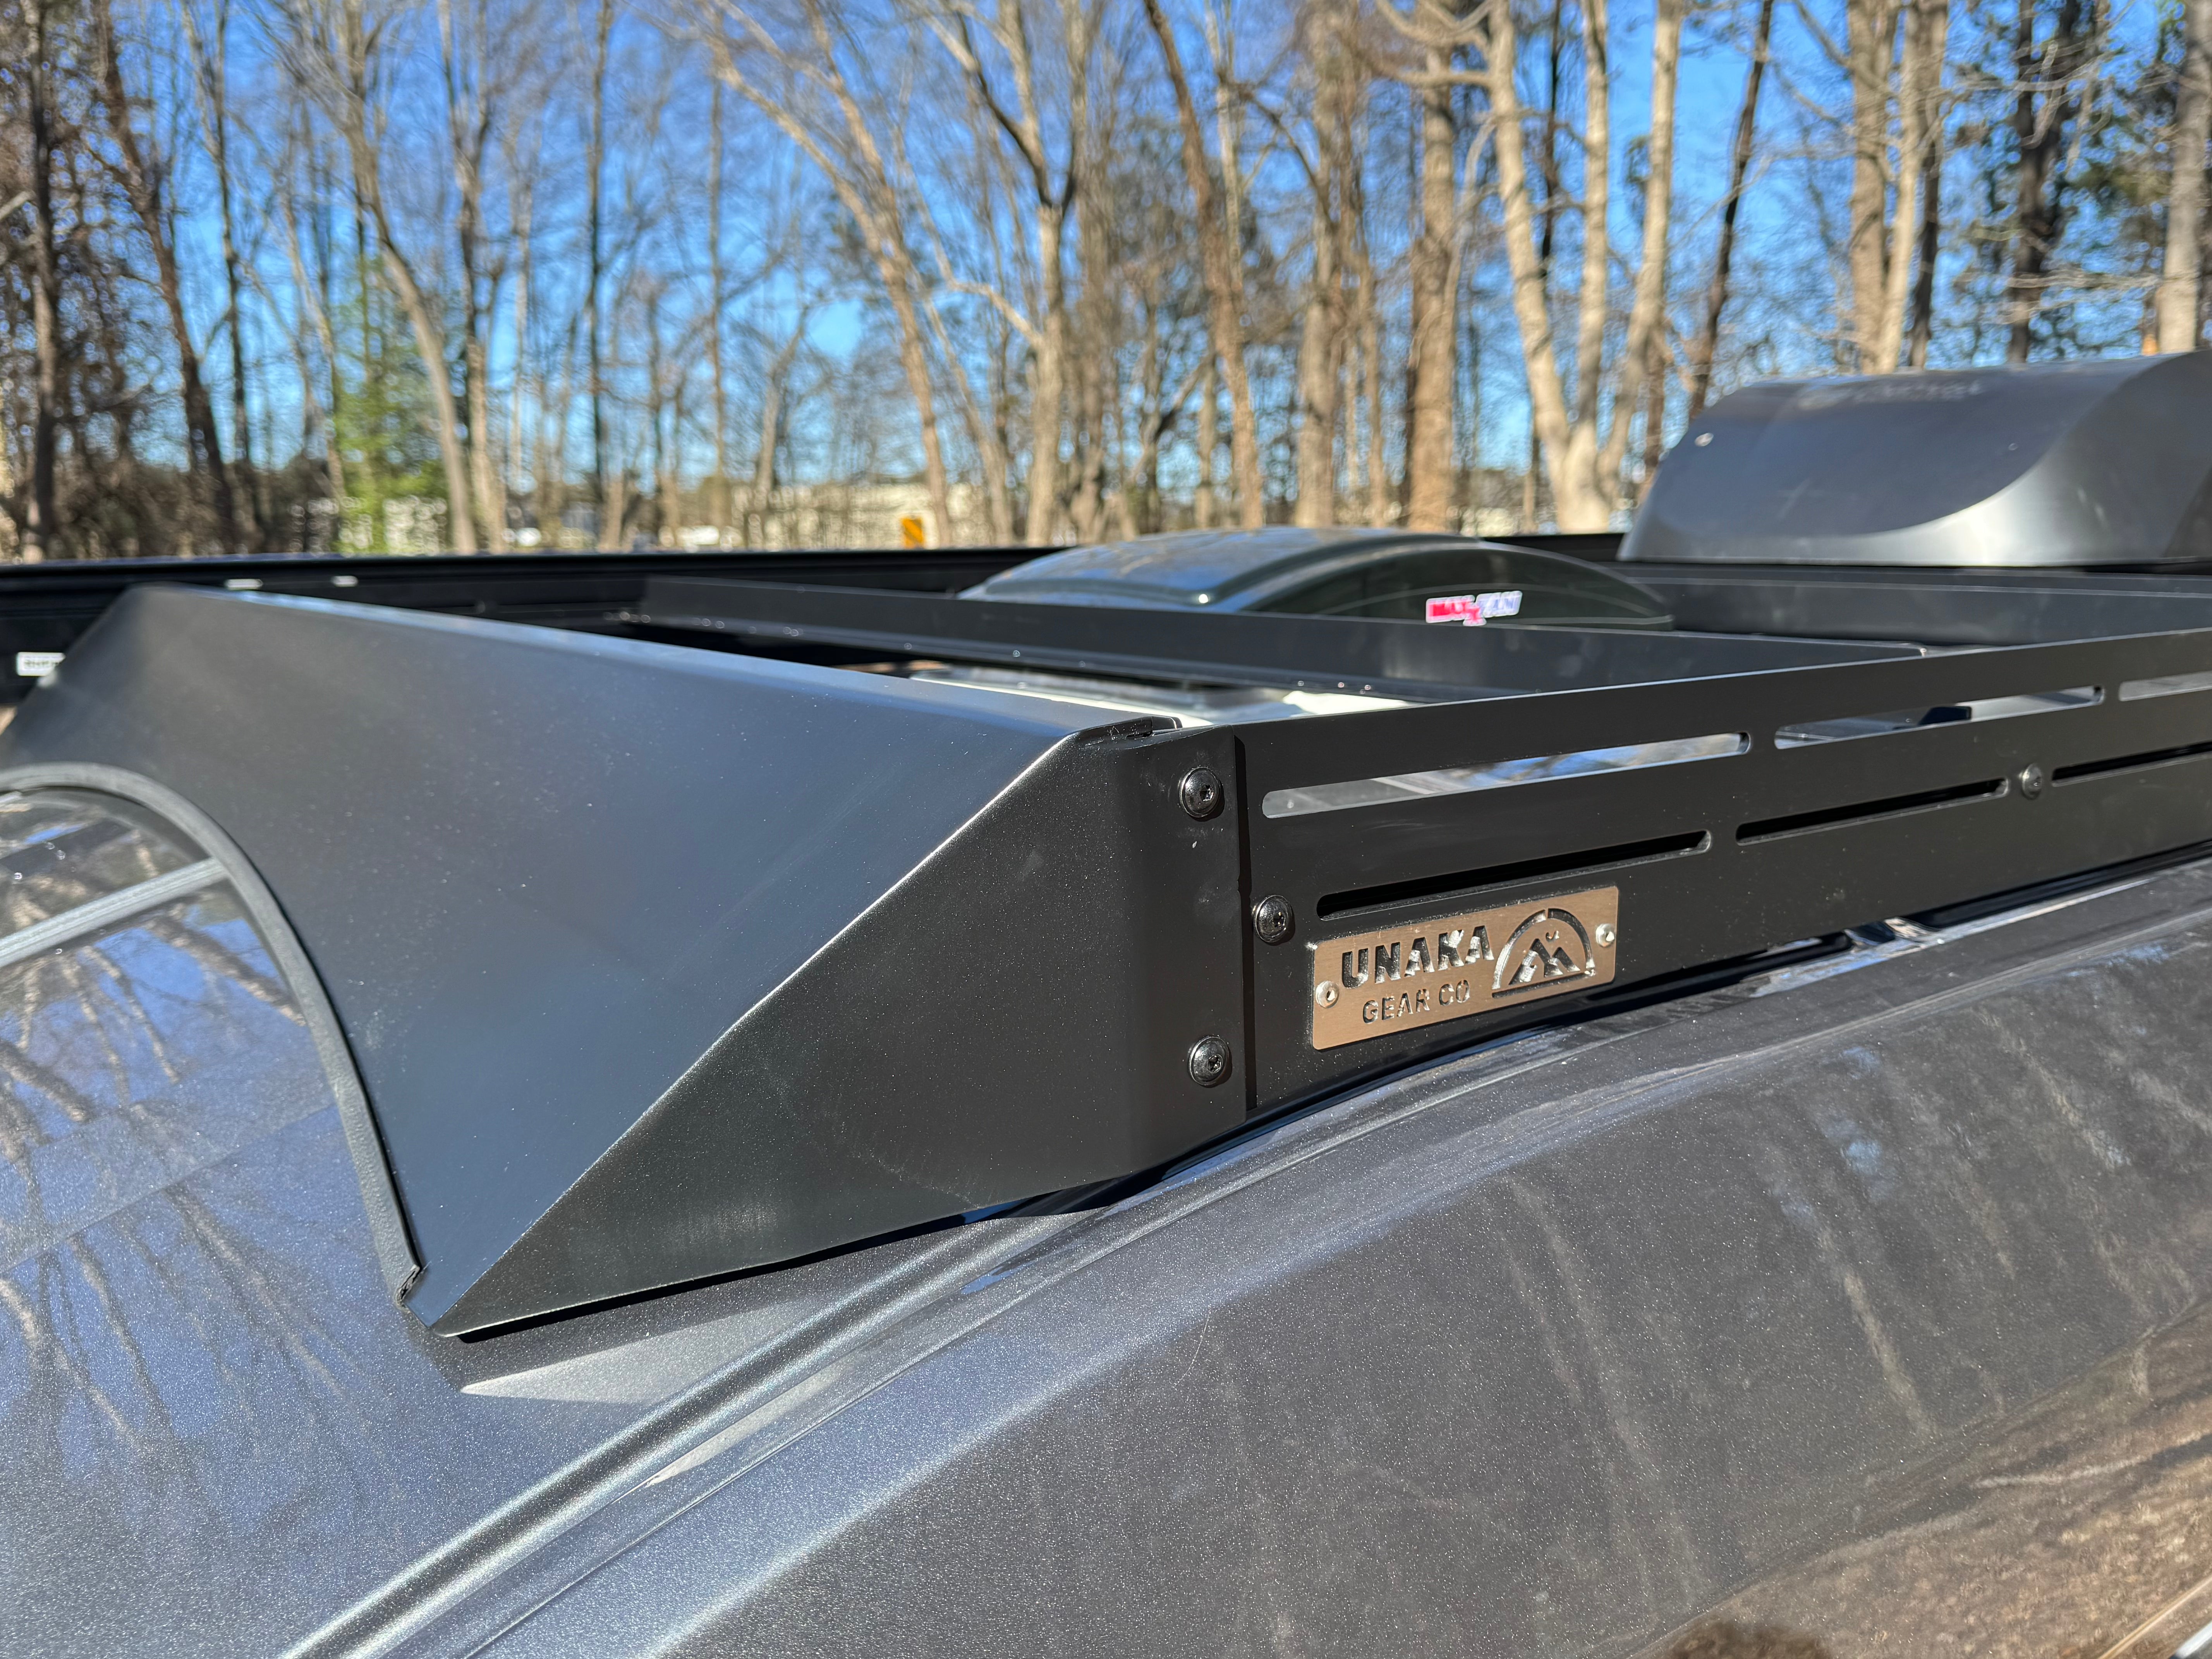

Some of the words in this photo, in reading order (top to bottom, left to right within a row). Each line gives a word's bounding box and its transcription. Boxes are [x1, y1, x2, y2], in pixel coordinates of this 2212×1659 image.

[1341, 925, 1494, 988] UNAKA
[1362, 989, 1430, 1024] GEAR
[1439, 980, 1470, 1006] CO
